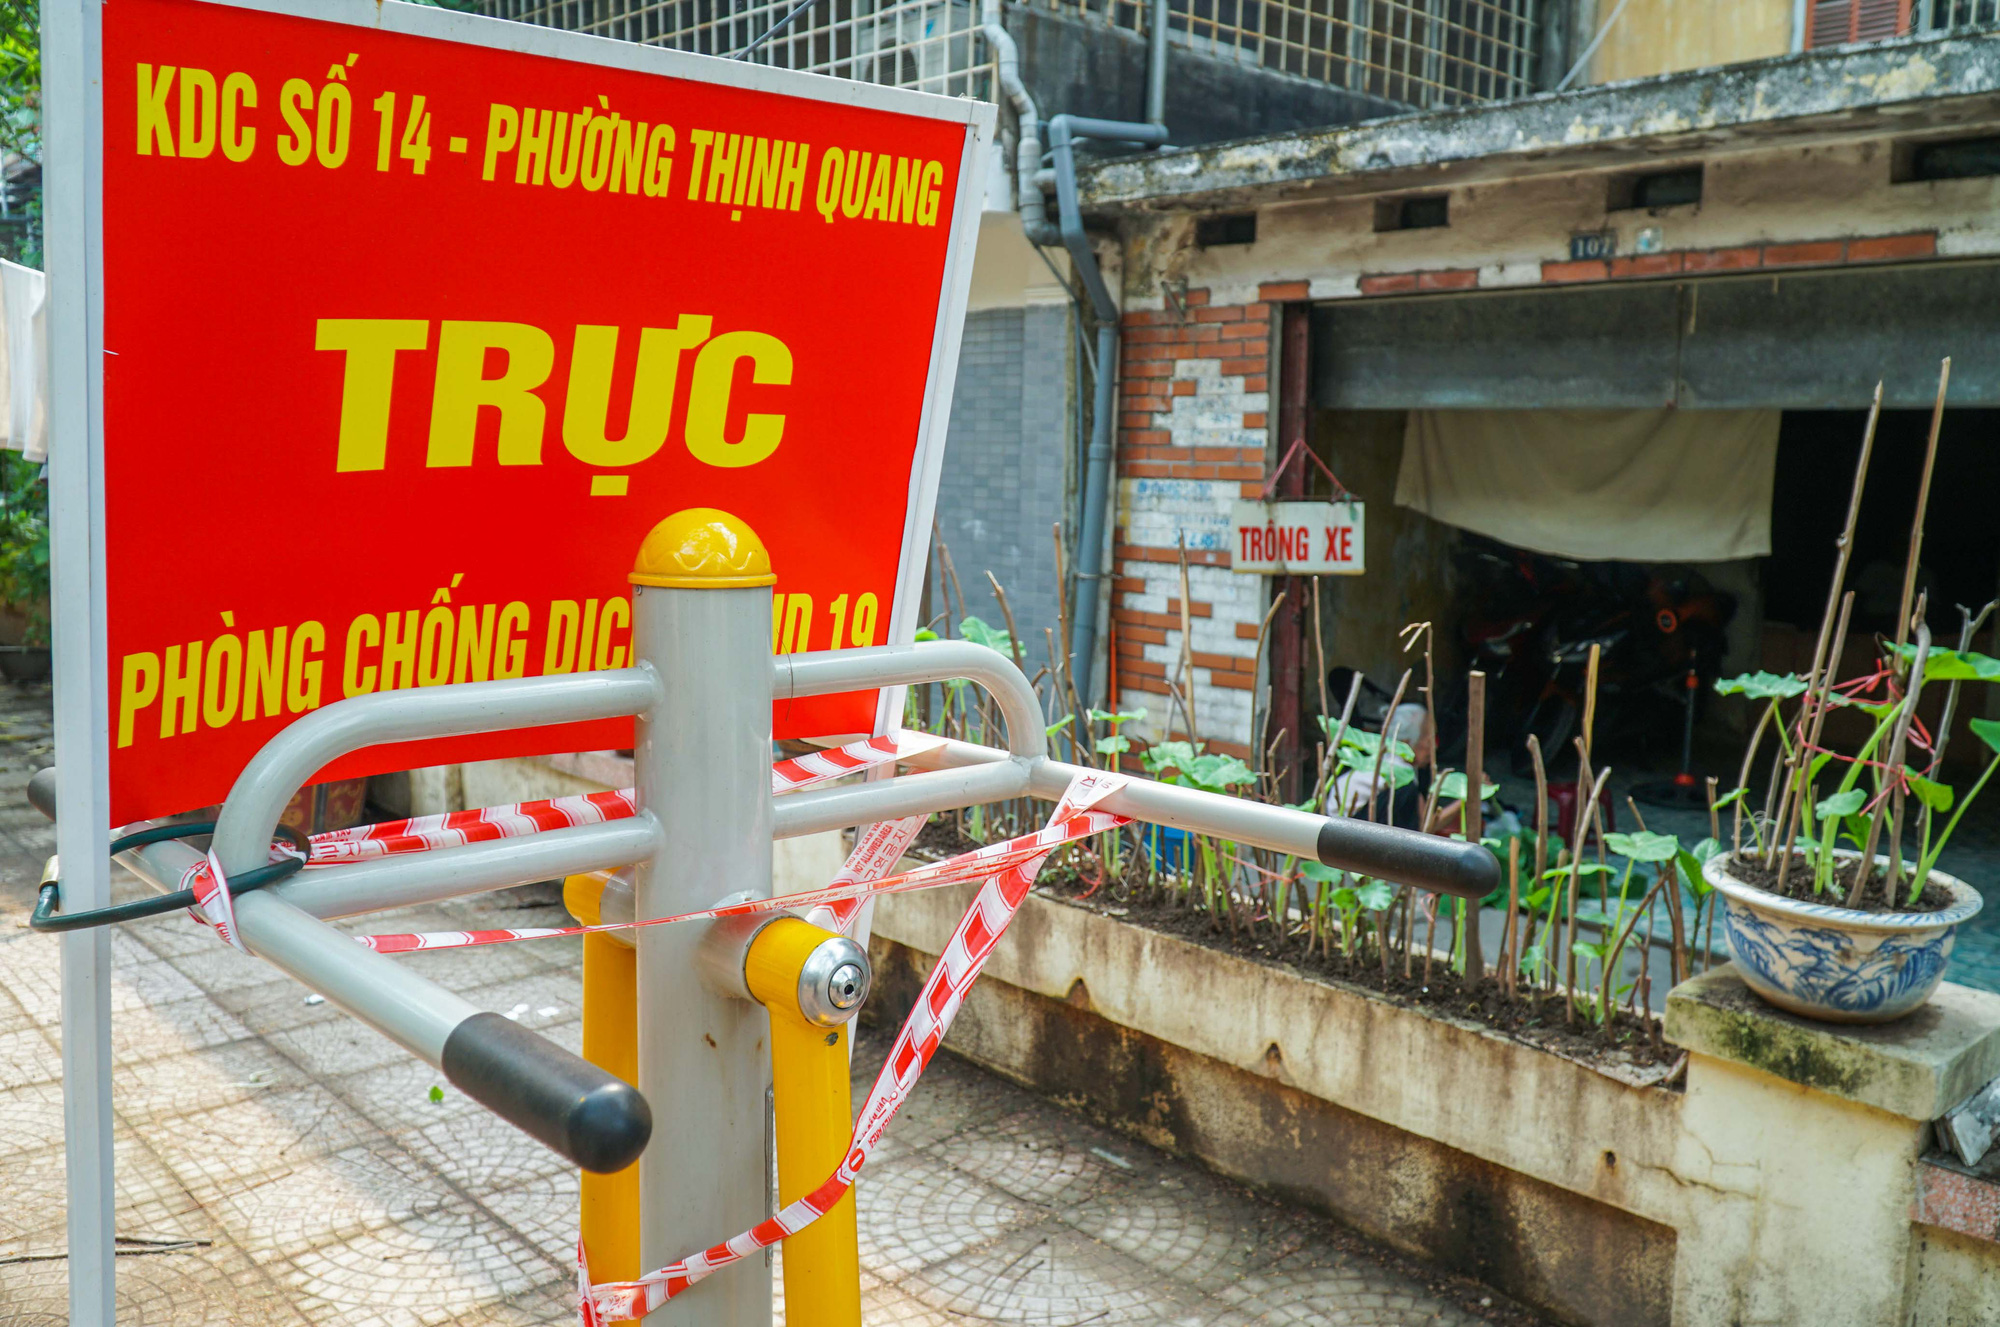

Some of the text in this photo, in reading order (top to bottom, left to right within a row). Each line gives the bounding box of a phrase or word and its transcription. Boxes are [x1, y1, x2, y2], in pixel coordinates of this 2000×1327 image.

[136, 52, 944, 227] KDC SỐ 14 - PHƯỜNG THỊNH QUANG
[314, 313, 794, 496] TRỰC
[1239, 518, 1309, 562] TRÔNG
[1324, 526, 1353, 562] XE
[117, 610, 325, 749] PHÒNG
[342, 572, 530, 700] CHỐNG
[542, 596, 634, 677] DIC
[829, 591, 879, 651] 19
[852, 824, 894, 875] NOT ALLOWED AREA
